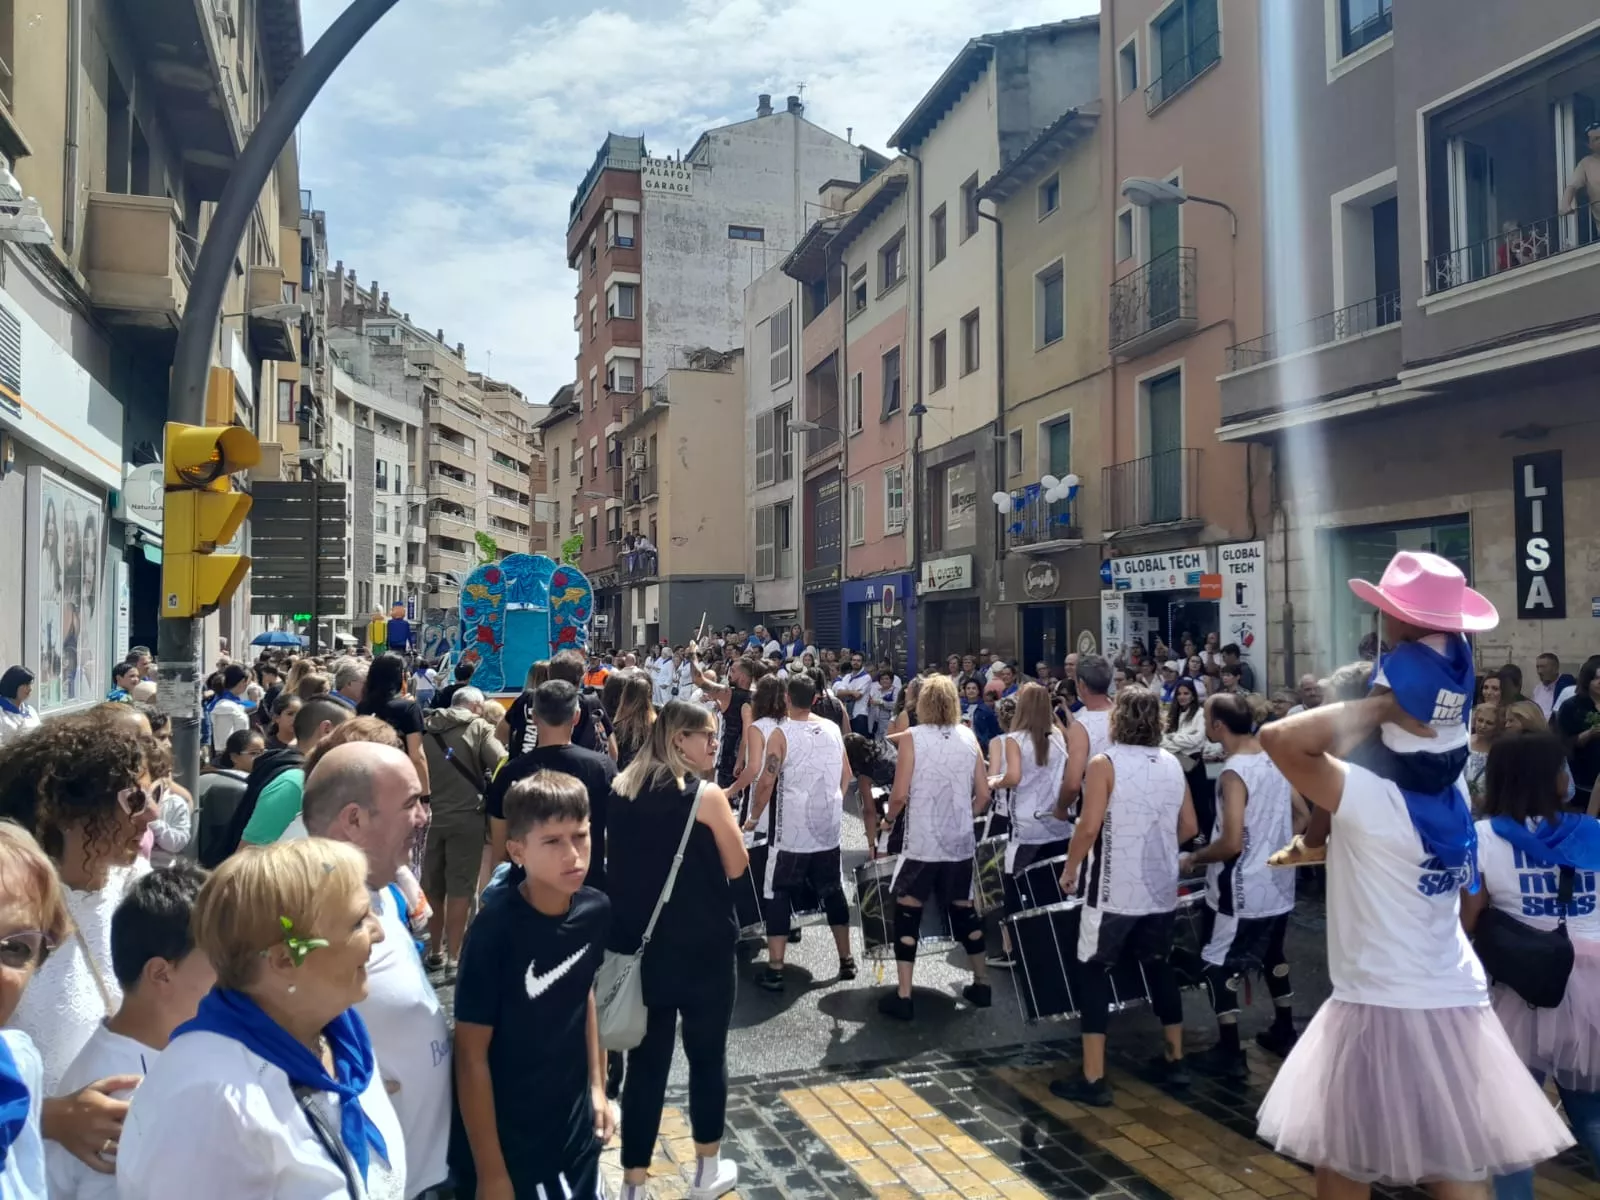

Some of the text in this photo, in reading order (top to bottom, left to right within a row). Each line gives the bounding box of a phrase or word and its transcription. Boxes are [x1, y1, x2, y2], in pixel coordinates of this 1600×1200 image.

[646, 158, 688, 171] HOSTAL
[642, 167, 692, 180] PALAFOX
[645, 180, 689, 192] GARAGE
[131, 503, 157, 511] Natural
[1523, 464, 1554, 609] LISA
[1223, 548, 1261, 561] GLOBAL
[1124, 554, 1201, 574] GLOBAL TECH
[1229, 562, 1255, 574] TECH
